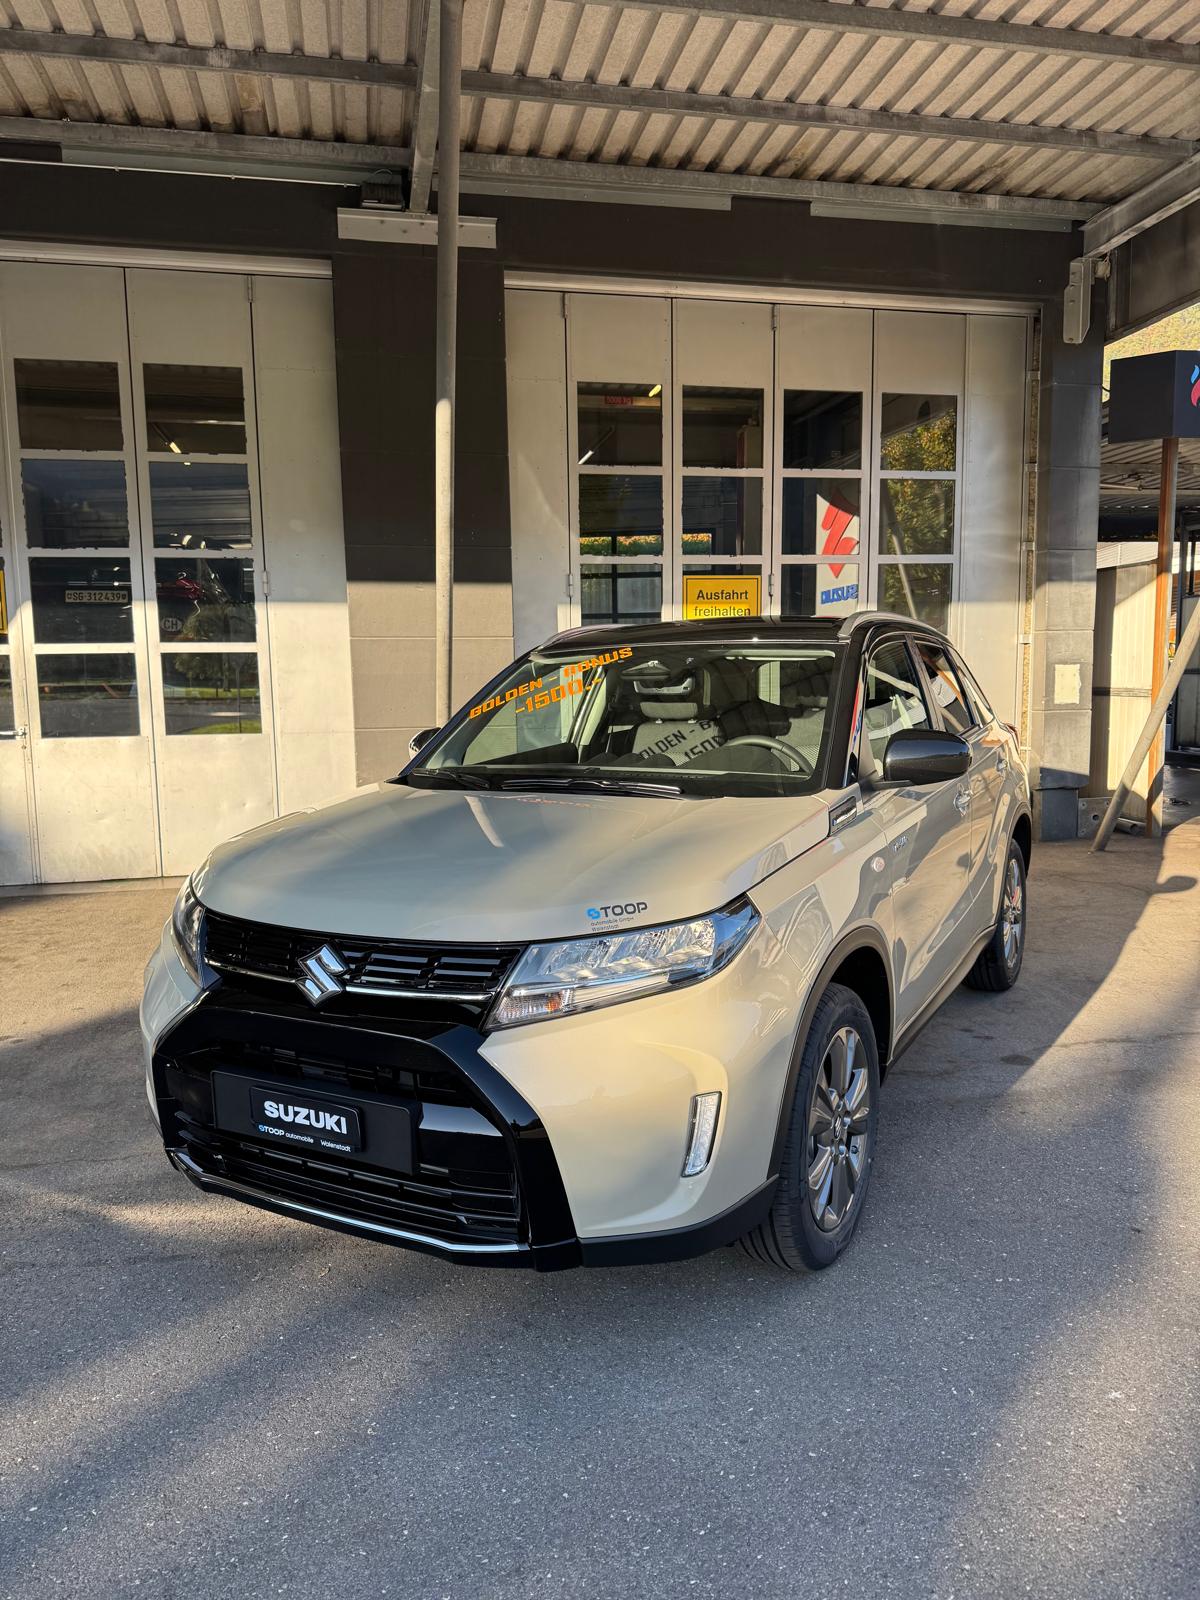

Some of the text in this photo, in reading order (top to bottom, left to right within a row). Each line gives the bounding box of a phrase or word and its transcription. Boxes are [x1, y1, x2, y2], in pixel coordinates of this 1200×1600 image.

[696, 589, 748, 600] Ausfahrt
[694, 605, 751, 617] freihalten
[163, 619, 178, 631] CH
[469, 677, 542, 719] GOLDEN
[563, 647, 633, 678] BONUS
[263, 1100, 348, 1134] SUZUKI
[285, 1132, 314, 1144] automobile
